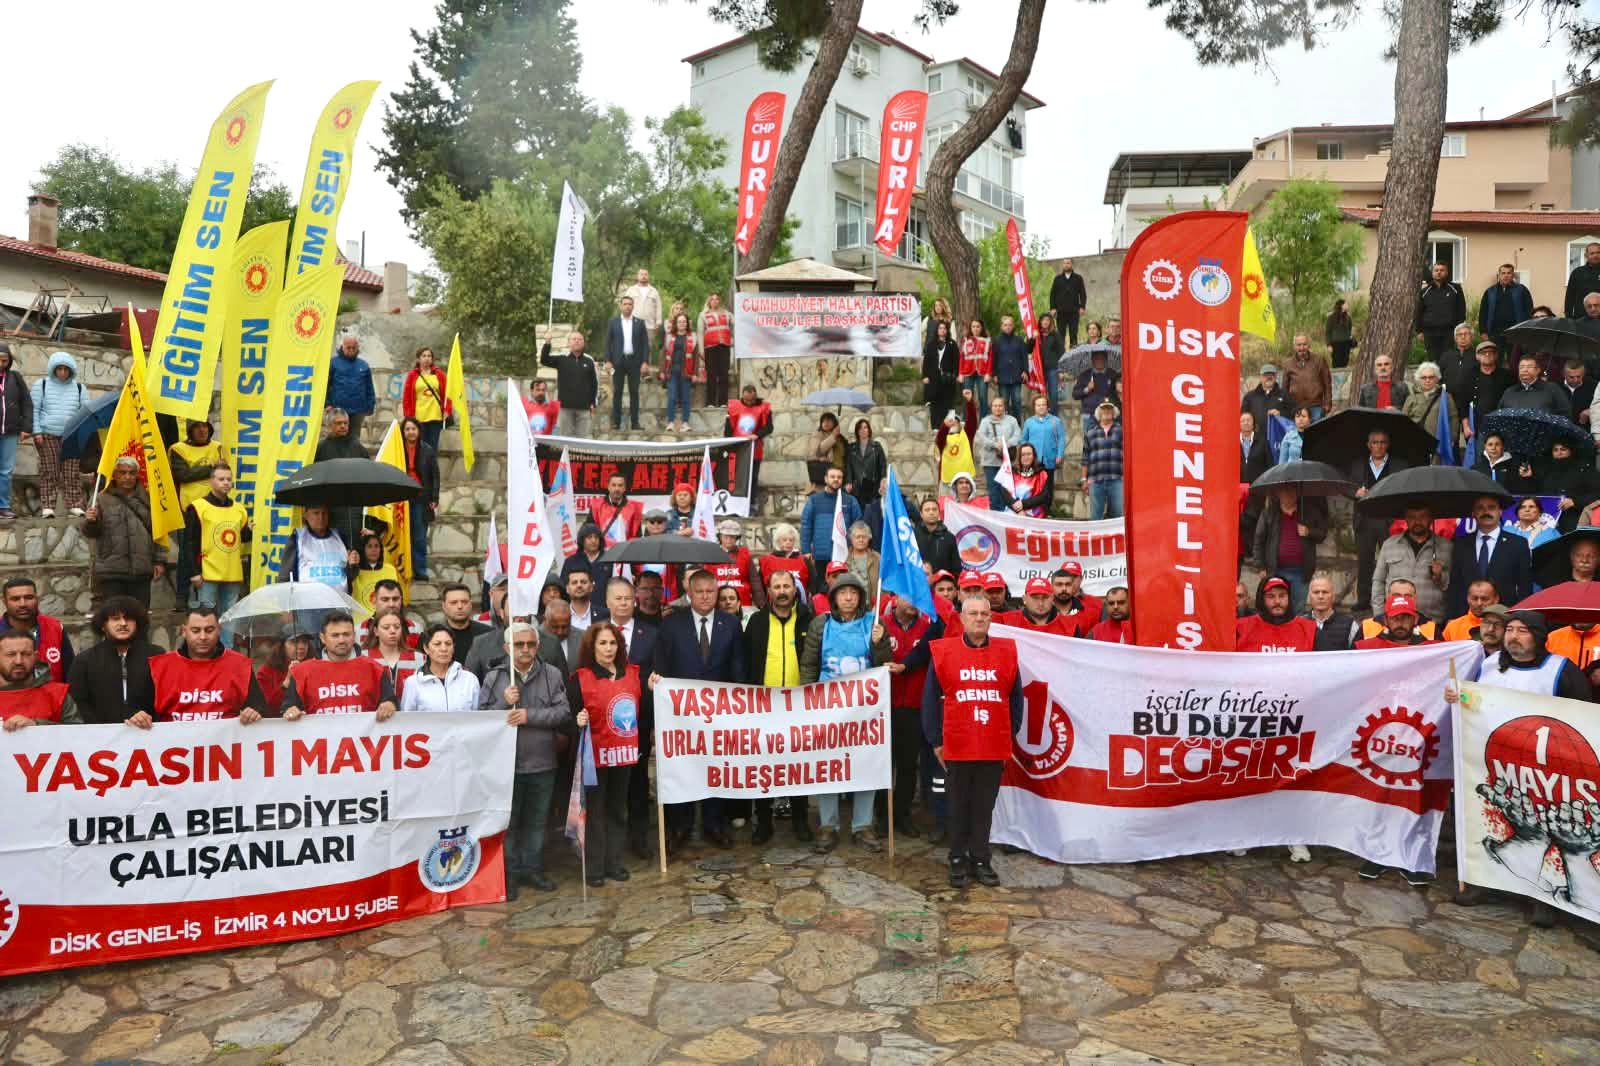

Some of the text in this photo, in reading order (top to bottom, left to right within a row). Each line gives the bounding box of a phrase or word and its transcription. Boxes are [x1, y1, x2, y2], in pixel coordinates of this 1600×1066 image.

[751, 122, 775, 134] CHP
[890, 121, 918, 132] CHP
[310, 148, 345, 216] SEN
[874, 137, 914, 242] URLA
[160, 171, 234, 402] EĞİTİM SEN
[742, 294, 913, 313] CUMHURİYET HALK PARTİSİ
[756, 313, 901, 329] URLA İLÇE BAŞKANLIĞI
[1138, 319, 1236, 361] DİSK
[237, 318, 270, 396] SEN
[280, 364, 314, 446] SEN
[1005, 527, 1126, 562] Eğitim
[318, 682, 360, 699] DİSK
[959, 666, 998, 681] DİSK
[179, 688, 223, 704] DİSK
[669, 687, 772, 723] YAŞASIN
[780, 689, 793, 711] 1
[803, 678, 879, 711] MAYIS
[955, 688, 1003, 703] GENEL
[973, 706, 990, 725] İŞ
[1145, 689, 1299, 716] işçiler birleşir
[662, 712, 885, 758] URLA EMEK ve DEMOKRASİ
[1133, 711, 1304, 739] BU DÜZEN
[14, 733, 432, 798] YAŞASIN 1 MAYIS
[1107, 731, 1317, 790] DEĞİŞİR!
[1370, 734, 1422, 761] DİSK
[1535, 726, 1551, 766] 1
[707, 753, 851, 794] BİLEŞENLERİ
[1493, 758, 1600, 804] MAYIS
[68, 790, 389, 847] URLA BELEDİYESİ
[109, 835, 356, 888] ÇALIŞANLARI
[50, 932, 102, 955] DİSK
[107, 919, 202, 947] GENEL-İŞ
[213, 914, 269, 936] İZMİR
[273, 913, 287, 927] 4
[354, 895, 399, 921] ŞUBE
